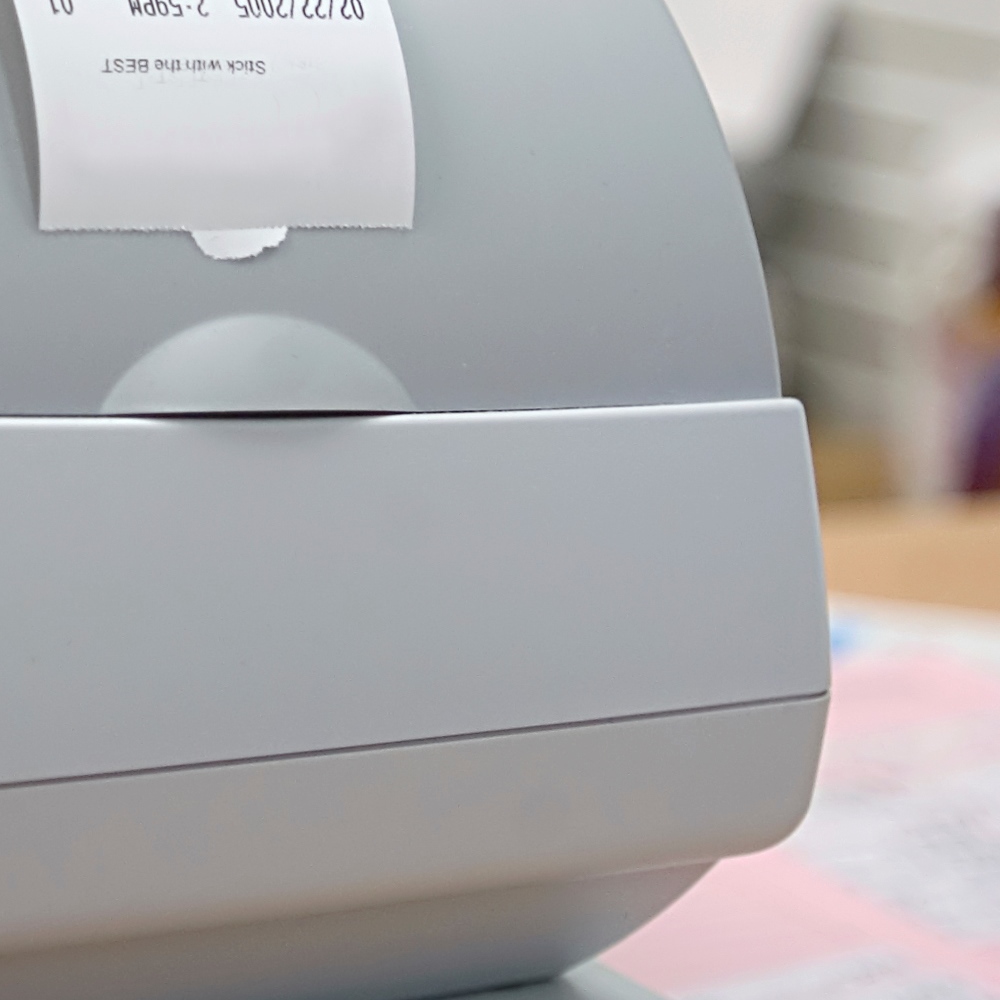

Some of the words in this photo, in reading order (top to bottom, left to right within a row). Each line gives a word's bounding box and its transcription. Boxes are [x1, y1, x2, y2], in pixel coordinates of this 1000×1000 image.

[101, 58, 149, 74] BEST
[154, 58, 181, 74] the
[185, 58, 222, 75] with
[226, 59, 266, 75] Stick
